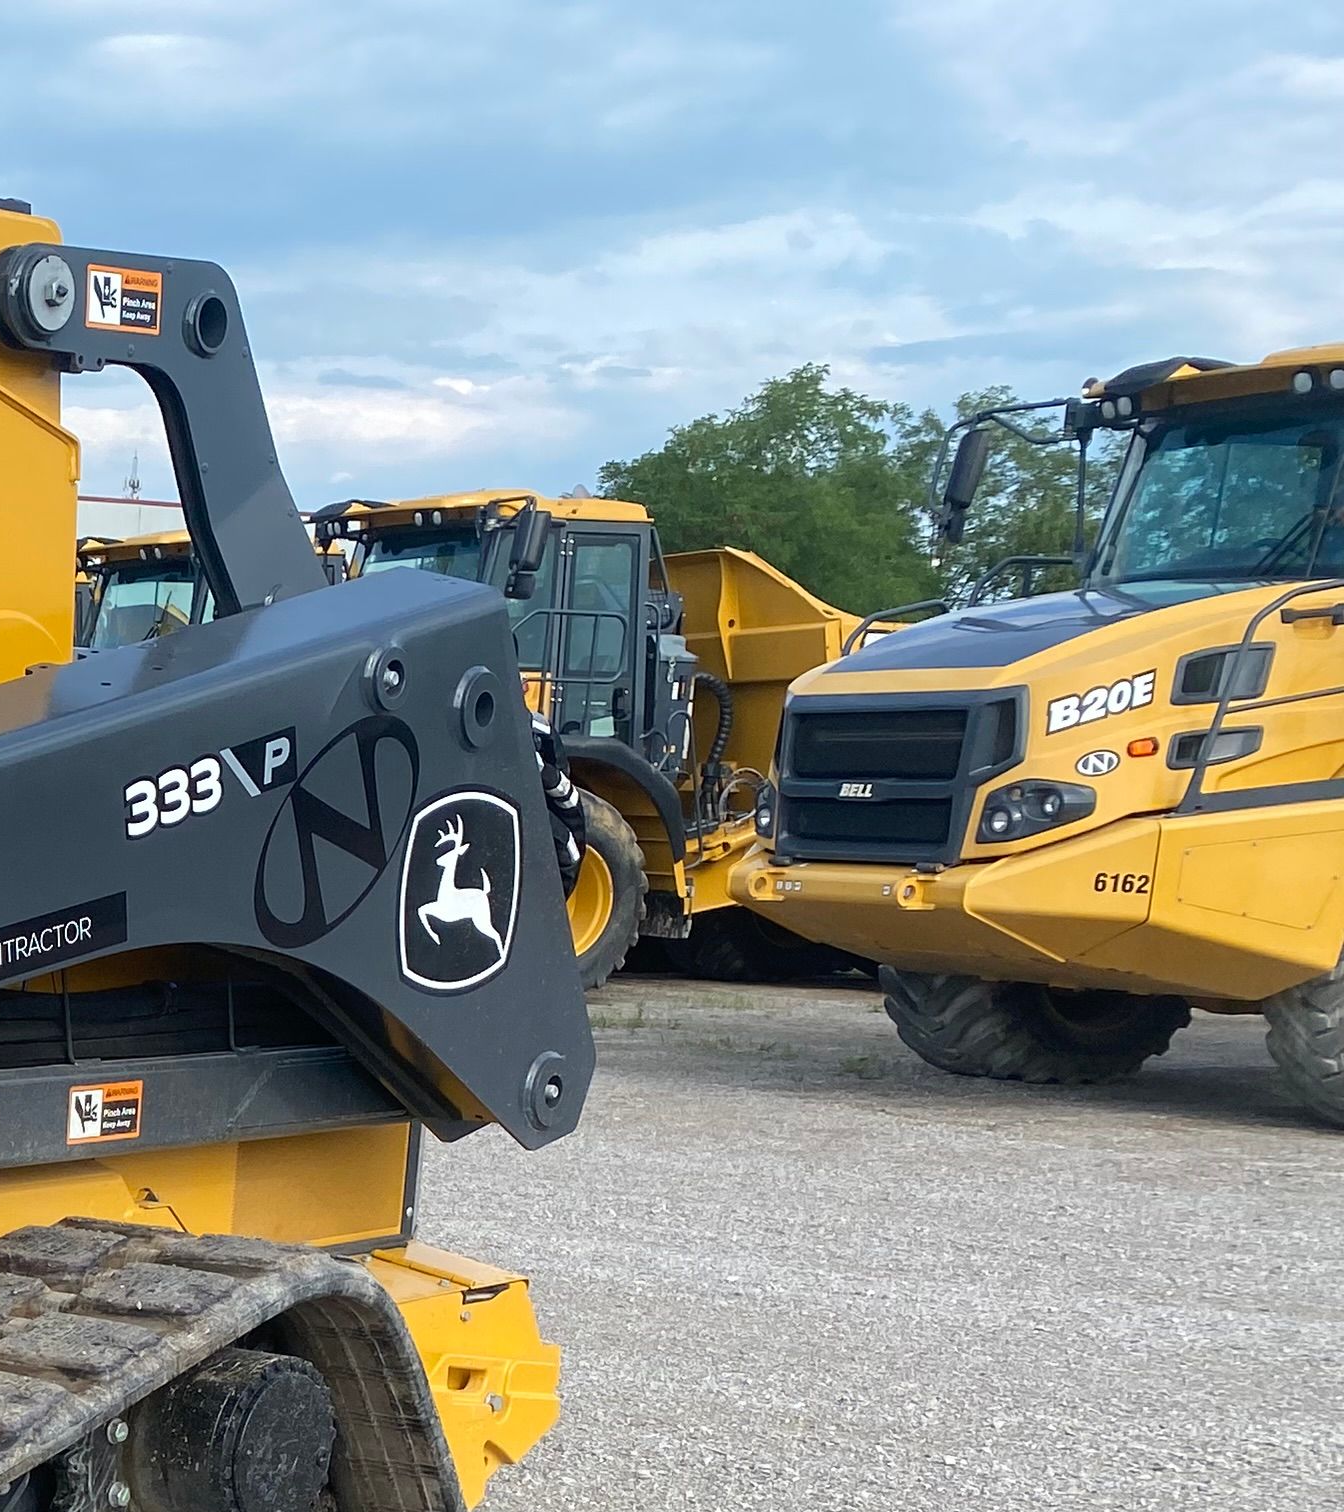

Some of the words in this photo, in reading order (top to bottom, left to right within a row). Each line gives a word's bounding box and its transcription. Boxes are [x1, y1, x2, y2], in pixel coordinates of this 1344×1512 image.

[122, 297, 140, 307] Pinch
[141, 299, 156, 310] Area
[122, 310, 136, 321] Keep
[136, 311, 151, 323] Away
[1048, 670, 1155, 734] B20E
[839, 783, 872, 797] BELL
[124, 757, 222, 838] 333
[1094, 872, 1150, 894] 6162
[103, 1108, 121, 1118] Pinch
[121, 1107, 136, 1116] Area
